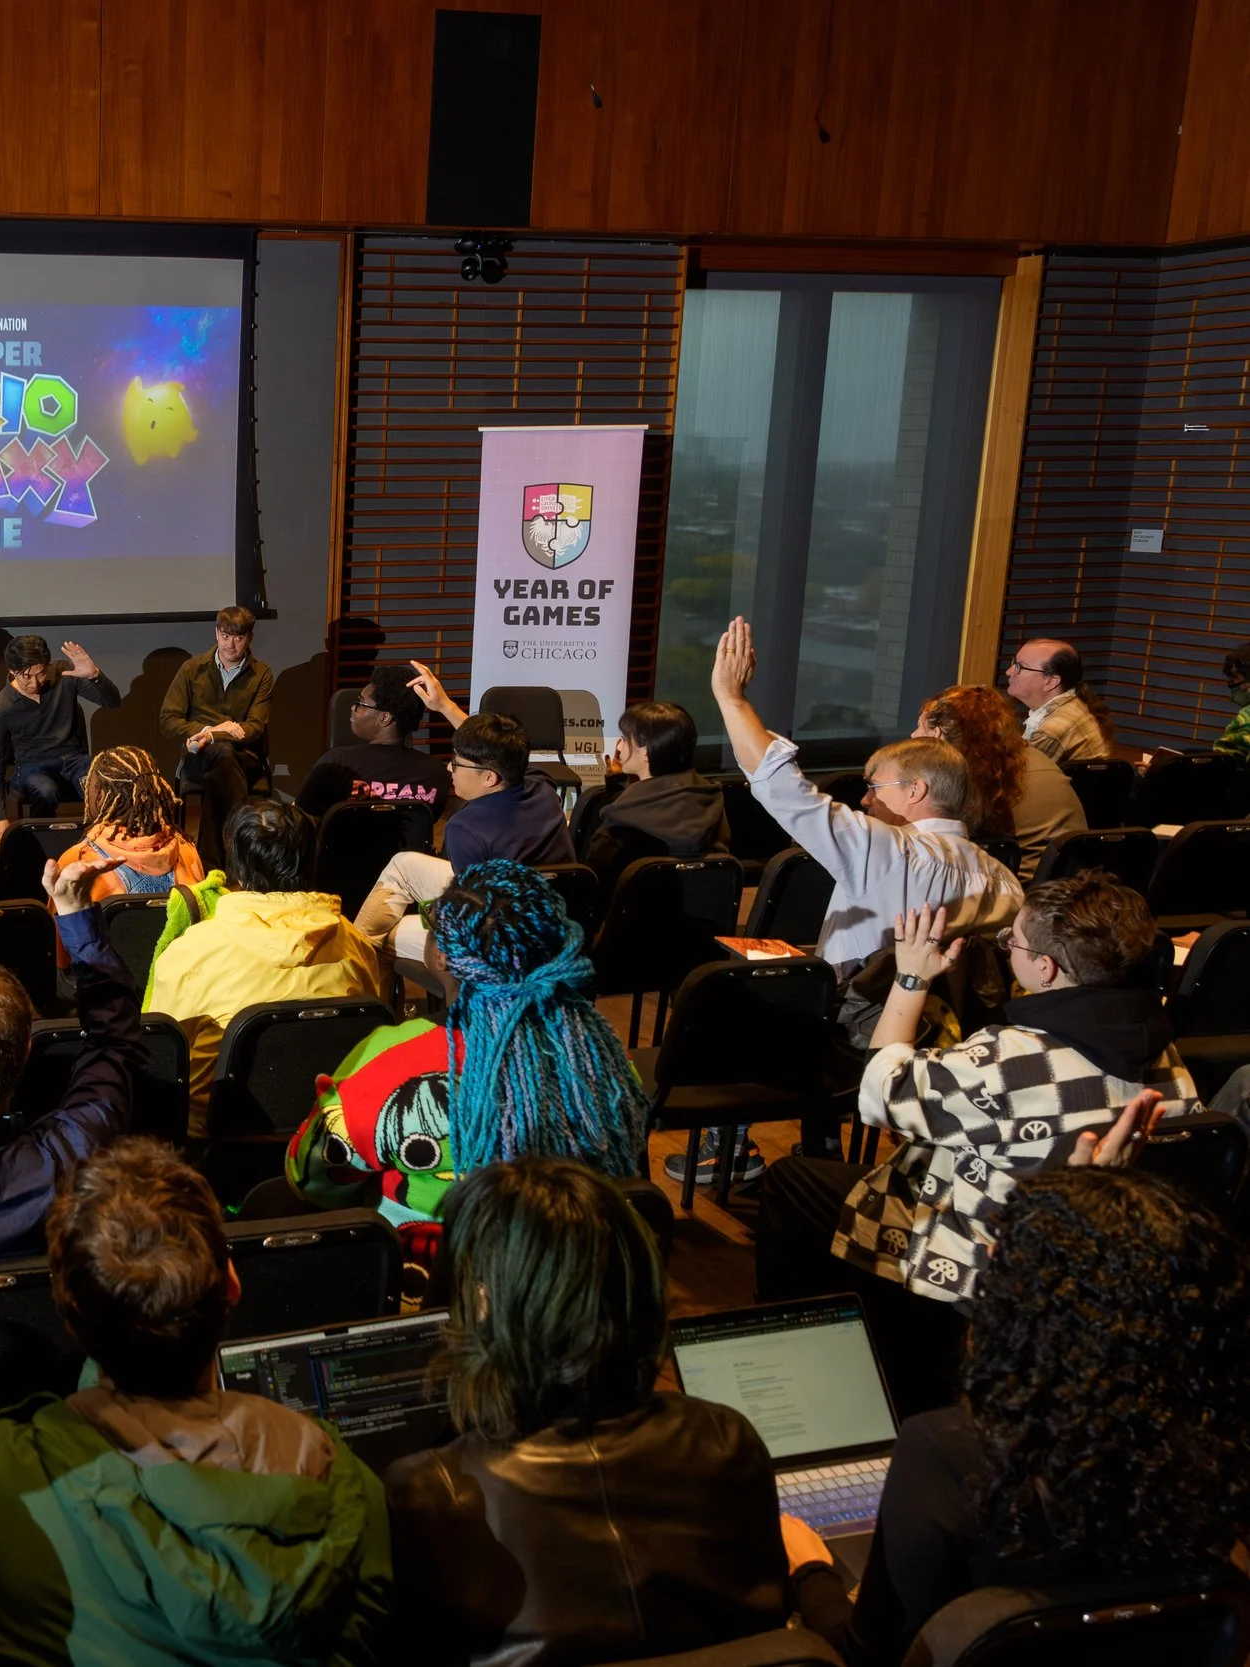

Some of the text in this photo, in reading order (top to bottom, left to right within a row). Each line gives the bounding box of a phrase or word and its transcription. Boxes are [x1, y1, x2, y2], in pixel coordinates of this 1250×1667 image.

[493, 579, 615, 600] YEAR OF
[503, 605, 601, 626] GAMES
[521, 647, 597, 660] CHICAGO
[562, 718, 605, 728] ES.COM
[575, 742, 601, 753] WGL
[351, 779, 438, 805] DREAM
